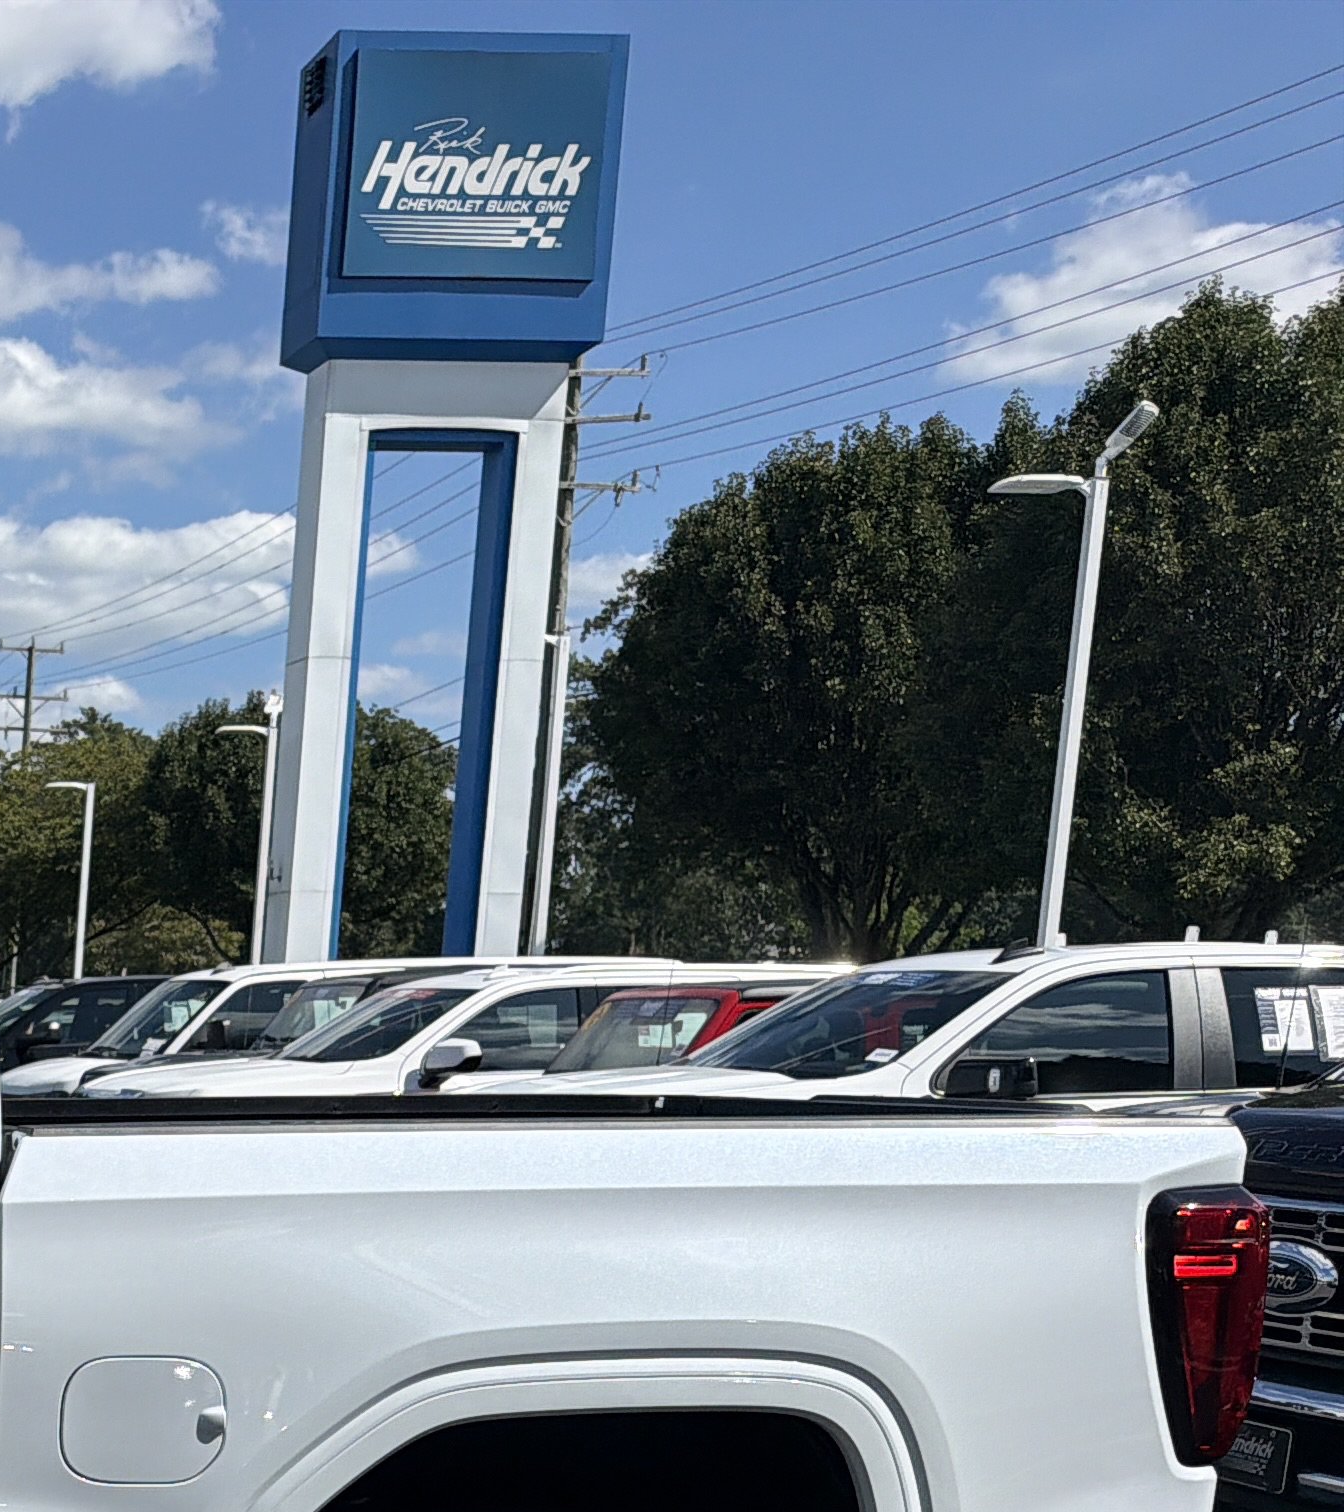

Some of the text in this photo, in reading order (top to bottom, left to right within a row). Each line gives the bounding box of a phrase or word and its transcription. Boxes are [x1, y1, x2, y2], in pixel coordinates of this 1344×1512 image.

[360, 140, 592, 210] Hendrick
[397, 197, 571, 214] CHEVROLET BUICK GMC
